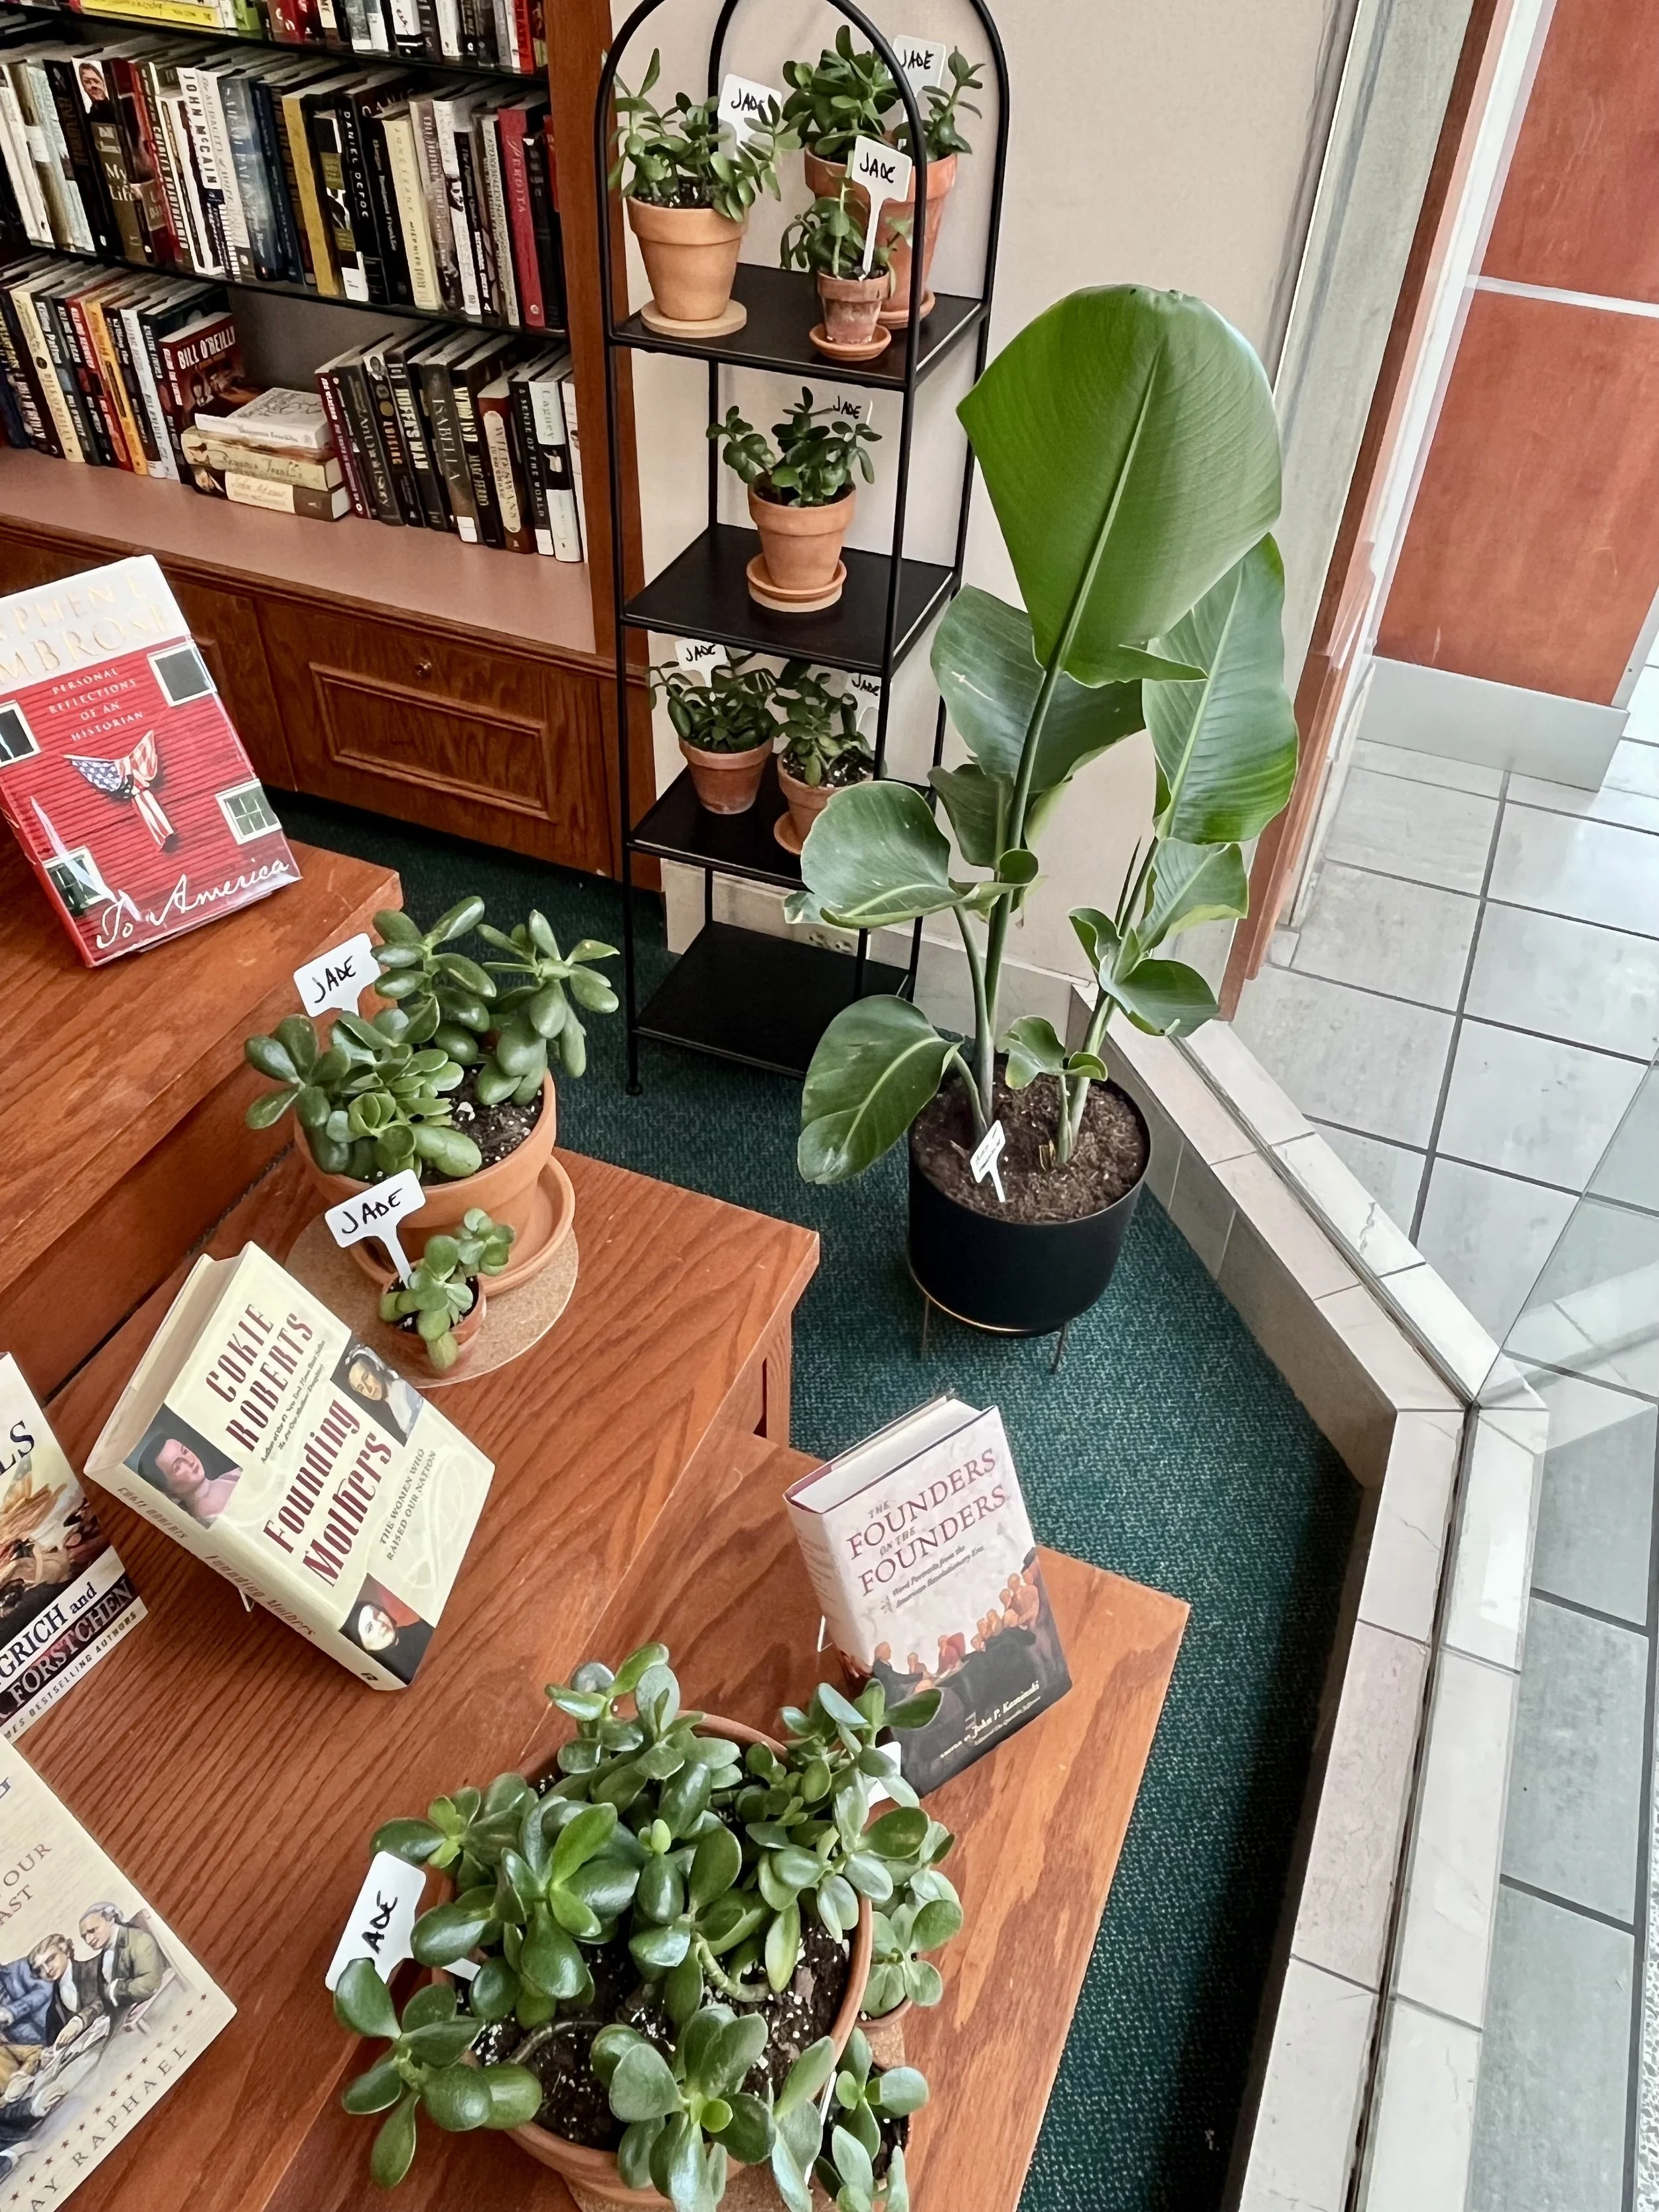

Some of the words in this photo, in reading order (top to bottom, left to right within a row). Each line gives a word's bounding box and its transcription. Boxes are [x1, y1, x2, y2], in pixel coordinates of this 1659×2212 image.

[900, 49, 934, 70] JADE
[182, 74, 203, 117] JOHN
[196, 125, 218, 184] McCAIN
[343, 111, 358, 164] DANIEL
[354, 172, 369, 218] DEFOE
[859, 153, 895, 183] JADE
[177, 344, 200, 370] BILL
[394, 388, 420, 439] HOFFA'S
[409, 441, 429, 470] MAN
[522, 400, 532, 435] SENSE
[832, 395, 862, 419] JADE
[432, 399, 461, 480] ISABELLA
[530, 457, 539, 477] THE
[534, 482, 545, 517] WORLD
[0, 602, 169, 684] MBROSE
[685, 642, 717, 663] JADE
[48, 680, 137, 714] REFLECTIONS
[52, 668, 119, 695] PERSONAL
[851, 673, 881, 697] JADE
[70, 711, 144, 741] HISTORIAN
[80, 707, 96, 721] OF
[103, 701, 121, 714] AN
[96, 897, 133, 949] To
[146, 858, 289, 926] America
[312, 956, 357, 1004] JADE
[341, 1187, 403, 1235] JADE
[206, 1303, 274, 1402] COKIE
[226, 1312, 313, 1452] ROBERTS
[263, 1399, 360, 1554] Founding
[380, 1516, 394, 1546] THE
[392, 1475, 413, 1519] WOMEN
[410, 1447, 425, 1477] WHO
[302, 1431, 392, 1587] Mothers
[386, 1518, 408, 1561] RAISED
[405, 1493, 420, 1518] OUR
[416, 1449, 437, 1494] NATION
[846, 1448, 997, 1560] FOUNDERS
[867, 1499, 890, 1519] THE
[857, 1484, 1007, 1597] FOUNDERS
[895, 1526, 916, 1545] THE
[0, 1603, 68, 1680] GRICH
[70, 1581, 96, 1615] and
[10, 1579, 135, 1706] FORSTCHEN
[29, 1653, 93, 1716] BESTSELLING
[94, 1611, 137, 1655] AUTHORS
[3, 1843, 52, 1887] OUR
[0, 1883, 34, 1925] AST
[70, 2047, 187, 2168] RAPHAEL
[31, 2176, 60, 2212] AY
